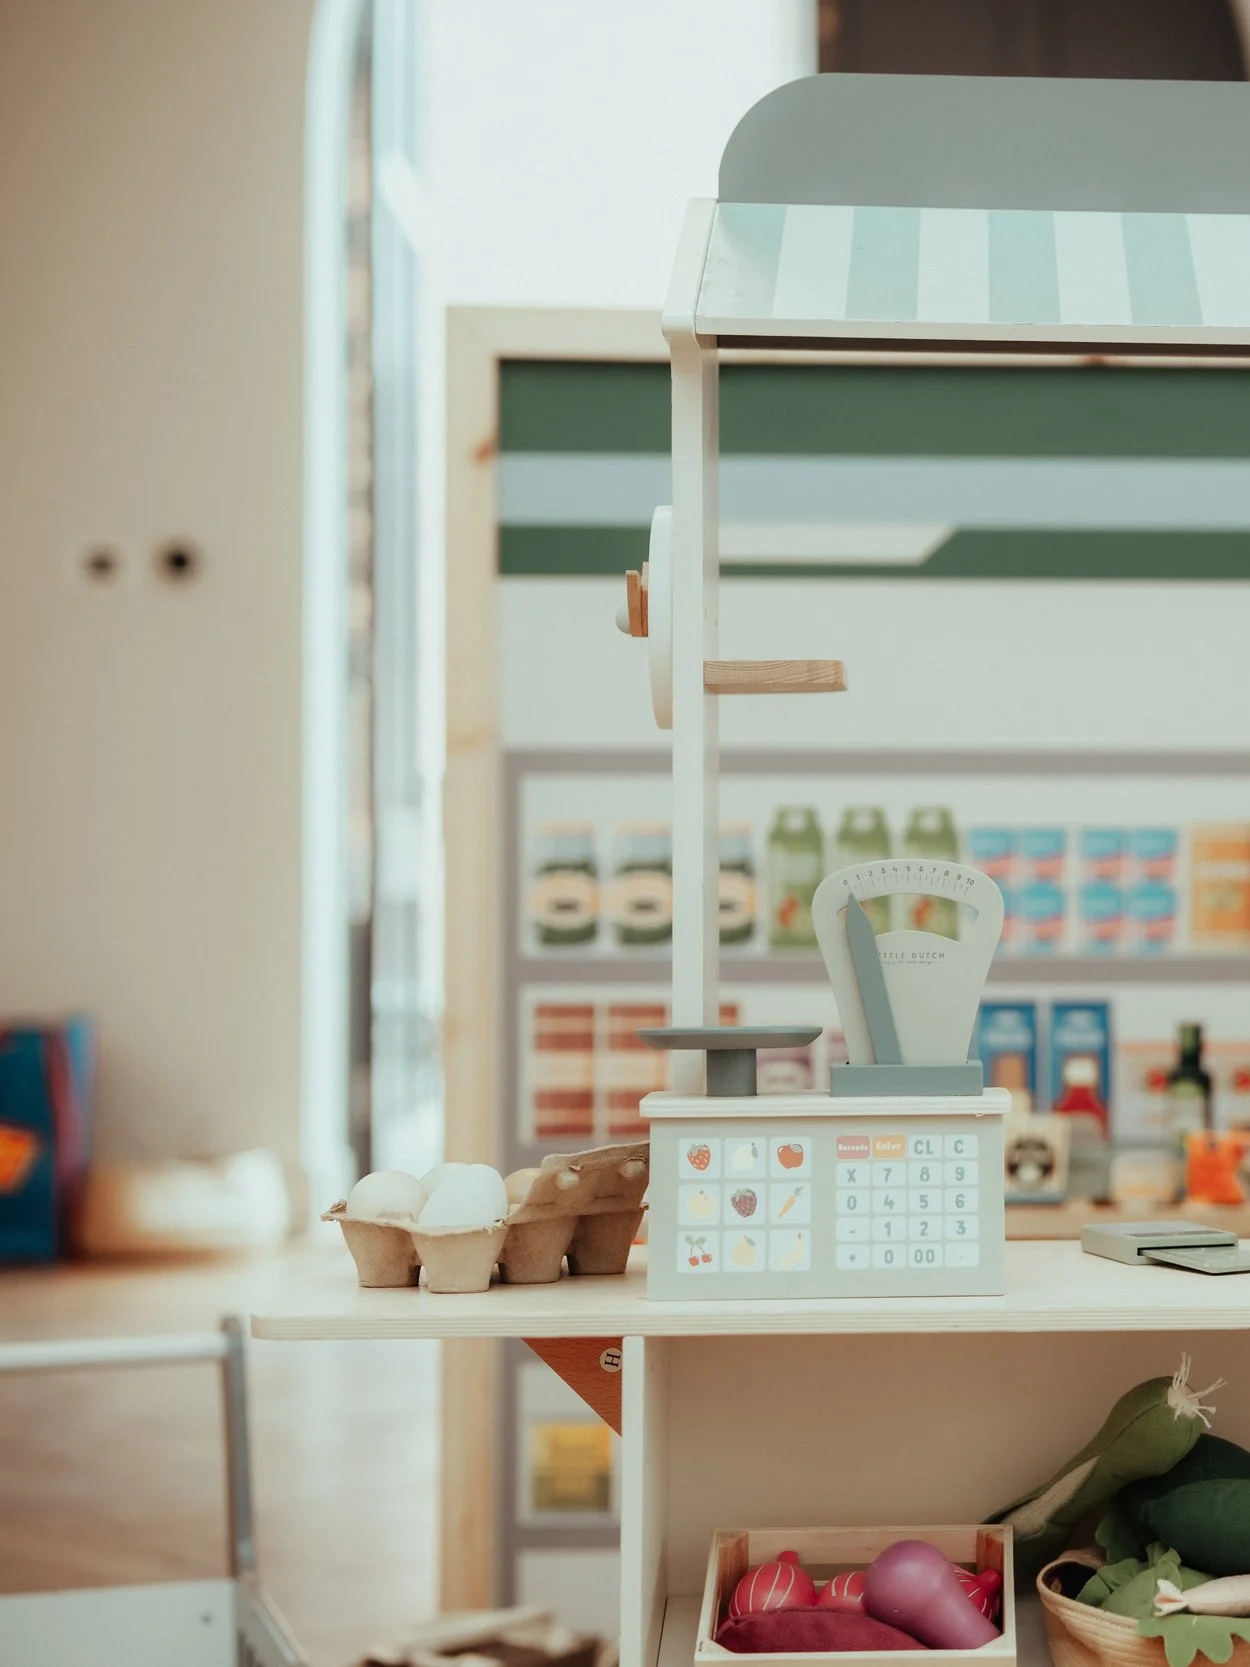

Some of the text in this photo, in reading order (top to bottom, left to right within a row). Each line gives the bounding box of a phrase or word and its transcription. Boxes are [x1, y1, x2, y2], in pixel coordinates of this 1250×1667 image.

[956, 873, 962, 881] 9
[966, 877, 975, 886] 10
[838, 1139, 964, 1155] Barcode Enter CL C
[883, 1168, 892, 1182] 7
[920, 1166, 930, 1182] 8
[955, 1166, 965, 1181] 9
[883, 1195, 894, 1210] 4
[919, 1194, 929, 1209] 5
[955, 1193, 965, 1209] 6
[884, 1221, 891, 1237] 1
[920, 1221, 929, 1237] 2
[956, 1220, 966, 1236] 3
[884, 1249, 894, 1264] 0
[914, 1248, 935, 1264] 00
[604, 1352, 621, 1368] H
